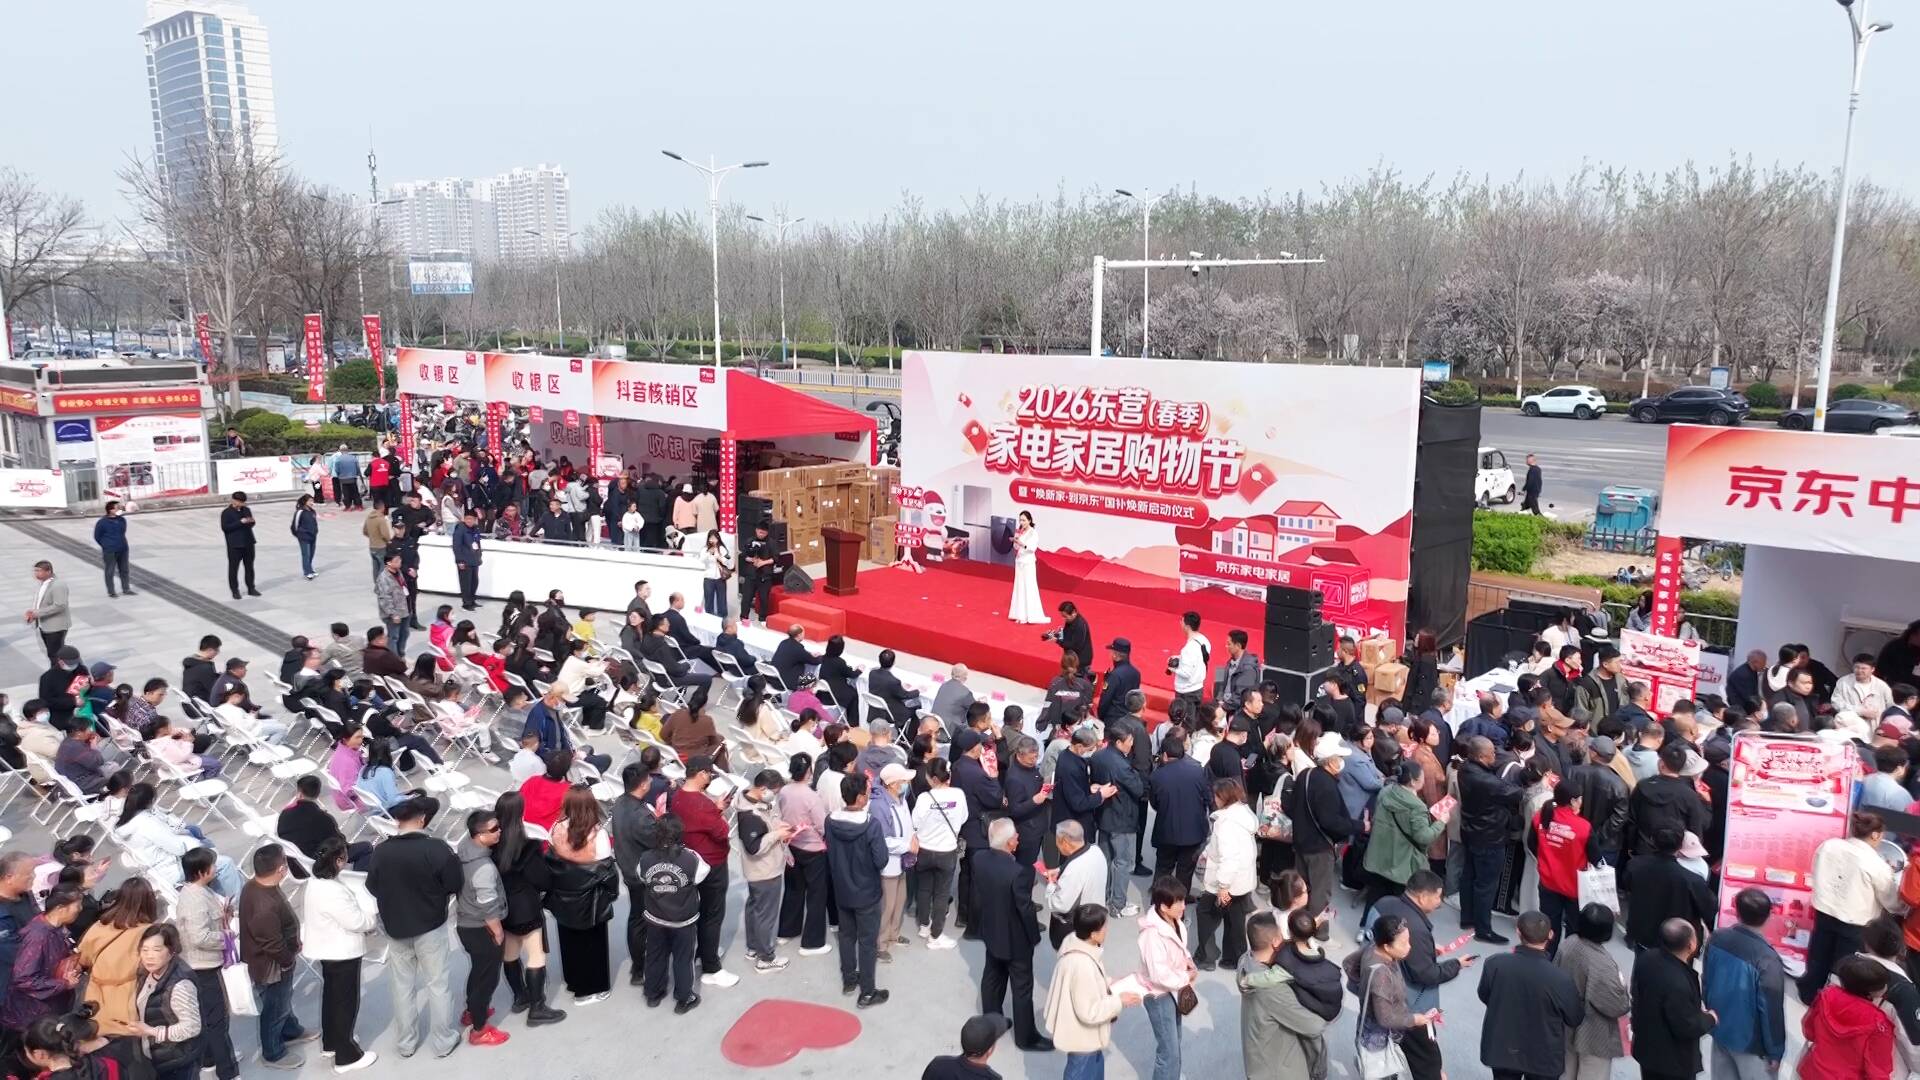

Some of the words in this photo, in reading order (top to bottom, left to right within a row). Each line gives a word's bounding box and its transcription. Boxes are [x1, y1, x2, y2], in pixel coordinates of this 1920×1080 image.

[419, 364, 459, 384] 收银区
[512, 371, 561, 394] 收银区
[616, 380, 698, 408] 抖音核销区
[648, 433, 704, 464] 收银区
[986, 425, 1243, 489] 家电家居购物节
[1725, 465, 1920, 524] 京东中
[1215, 560, 1290, 583] 京东家电家居
